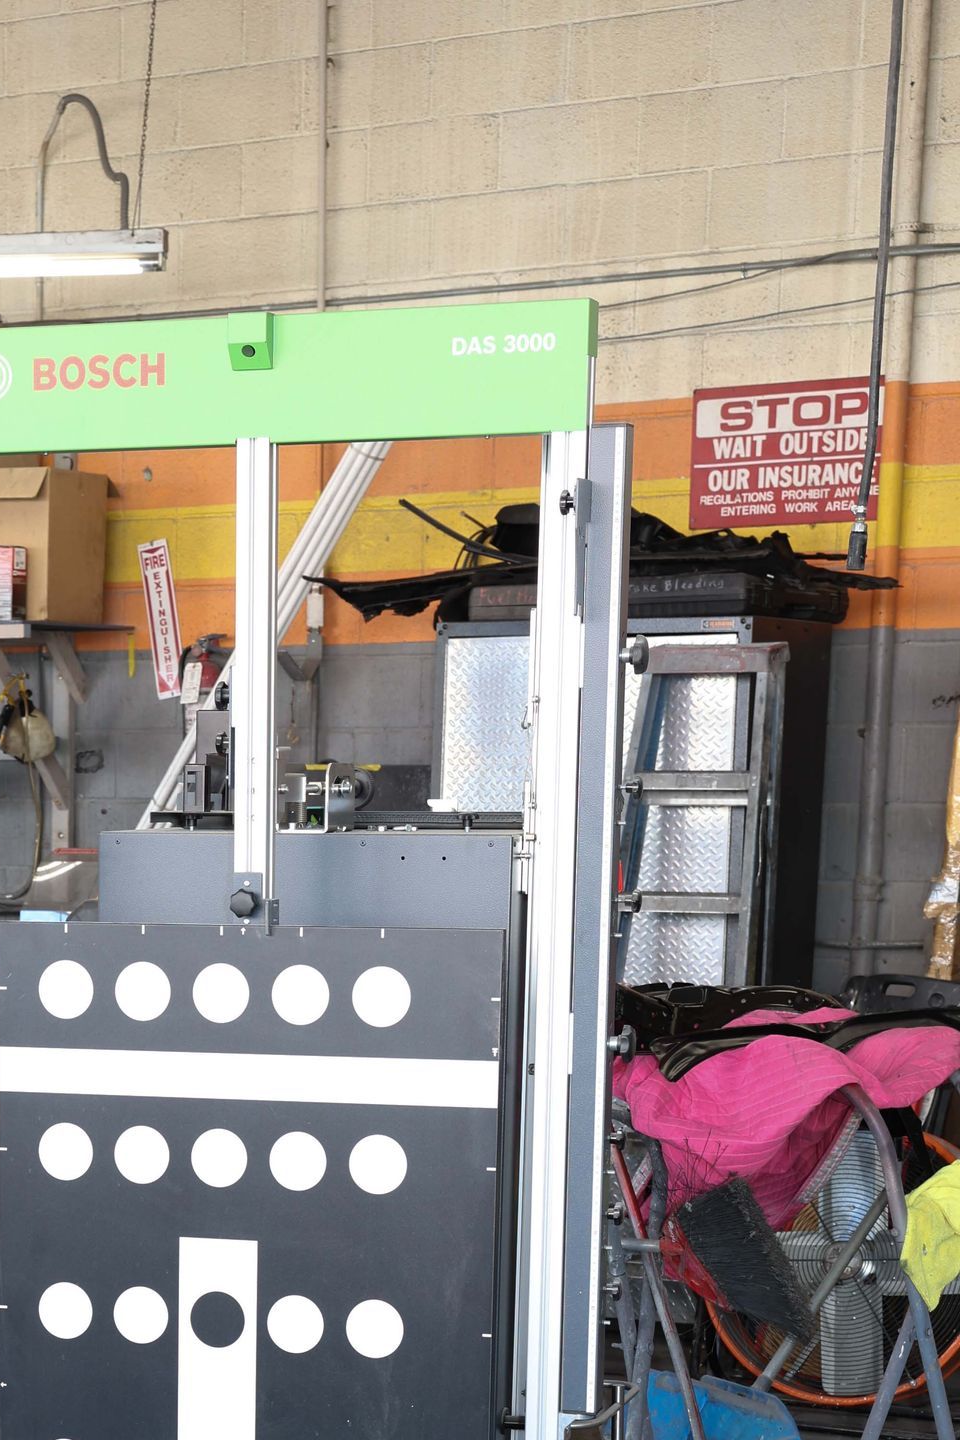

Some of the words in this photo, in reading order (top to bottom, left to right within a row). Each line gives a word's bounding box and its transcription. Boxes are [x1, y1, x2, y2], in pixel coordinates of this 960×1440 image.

[451, 335, 497, 356] DAS
[503, 332, 557, 353] 3000
[32, 352, 166, 392] BOSCH
[720, 391, 869, 433] STOP
[712, 435, 767, 460] WAIT
[779, 428, 869, 456] OUTSIDE
[707, 468, 751, 492] OUR
[757, 460, 877, 489] INSURANC
[699, 490, 775, 506] REGULATIONS
[781, 487, 831, 501] PROHIBIT
[834, 484, 880, 498] ANYE
[720, 502, 777, 517] ENTERING
[784, 501, 818, 513] WORK
[824, 499, 857, 513] AREA
[143, 553, 166, 571] FIRE
[152, 571, 174, 682] EXTINGUISHER
